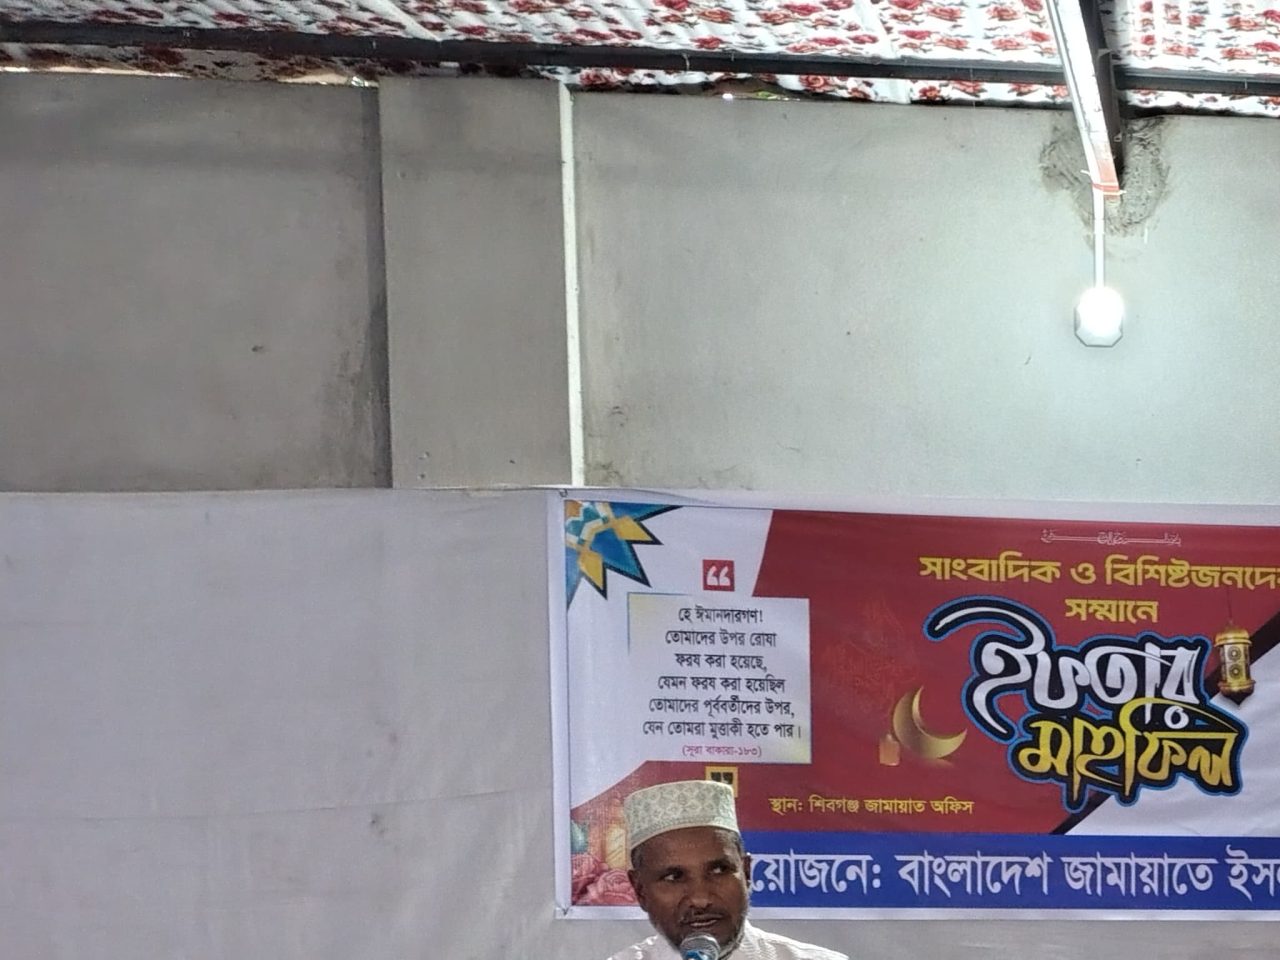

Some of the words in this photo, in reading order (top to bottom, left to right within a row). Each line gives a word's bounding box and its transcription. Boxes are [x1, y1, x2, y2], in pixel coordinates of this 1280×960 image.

[919, 551, 1061, 583] সাংবাদিক
[1071, 564, 1096, 584] ও
[678, 607, 693, 623] হে
[1065, 598, 1159, 623] সম্মানে
[665, 629, 715, 645] তোমাদের
[720, 628, 746, 646] উপর
[704, 654, 726, 668] করা
[934, 606, 1202, 734] ইফতার
[657, 675, 687, 690] যেমন
[720, 677, 741, 692] করা
[745, 673, 786, 694] হয়েছিল
[649, 698, 699, 713] তোমাদের
[642, 720, 663, 734] যেন
[667, 721, 705, 736] তোমরা
[746, 722, 770, 737] হতে
[1018, 696, 1239, 801] মাহফিল
[810, 794, 859, 814] শিবগঞ্জ
[864, 799, 926, 816] জামায়াত
[930, 796, 974, 815] অফিস
[748, 848, 881, 895] য়োজনে:
[896, 850, 1052, 898] বাংলাদেশ
[1061, 852, 1219, 898] জামায়াতে
